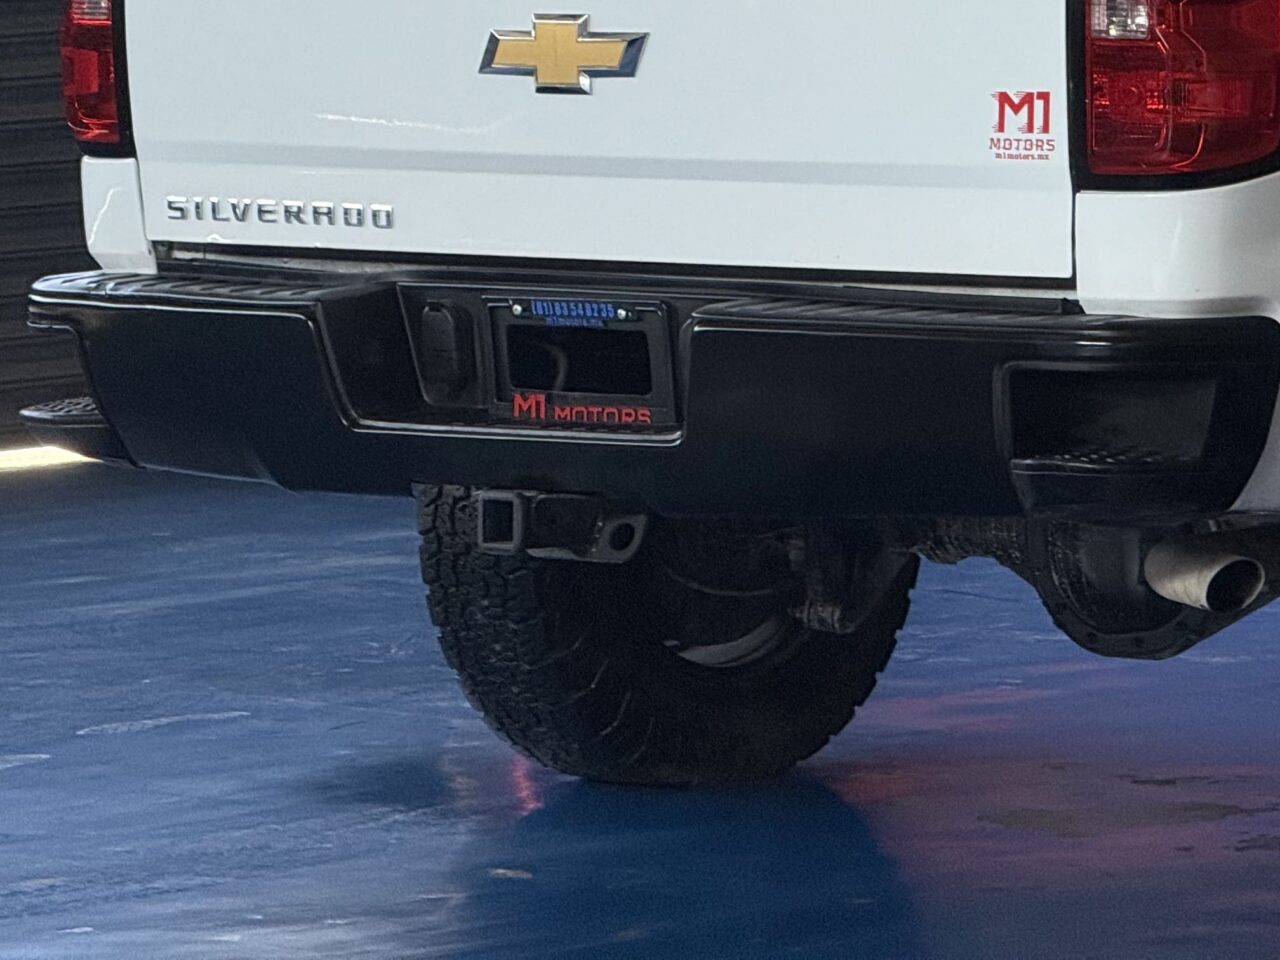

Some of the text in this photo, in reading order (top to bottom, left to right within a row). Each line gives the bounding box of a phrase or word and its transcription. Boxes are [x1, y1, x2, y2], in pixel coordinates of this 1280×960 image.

[991, 90, 1050, 134] M1
[989, 137, 1055, 151] MOTORS
[166, 195, 393, 229] SILVERADO
[513, 392, 651, 424] M1 MOTORS
